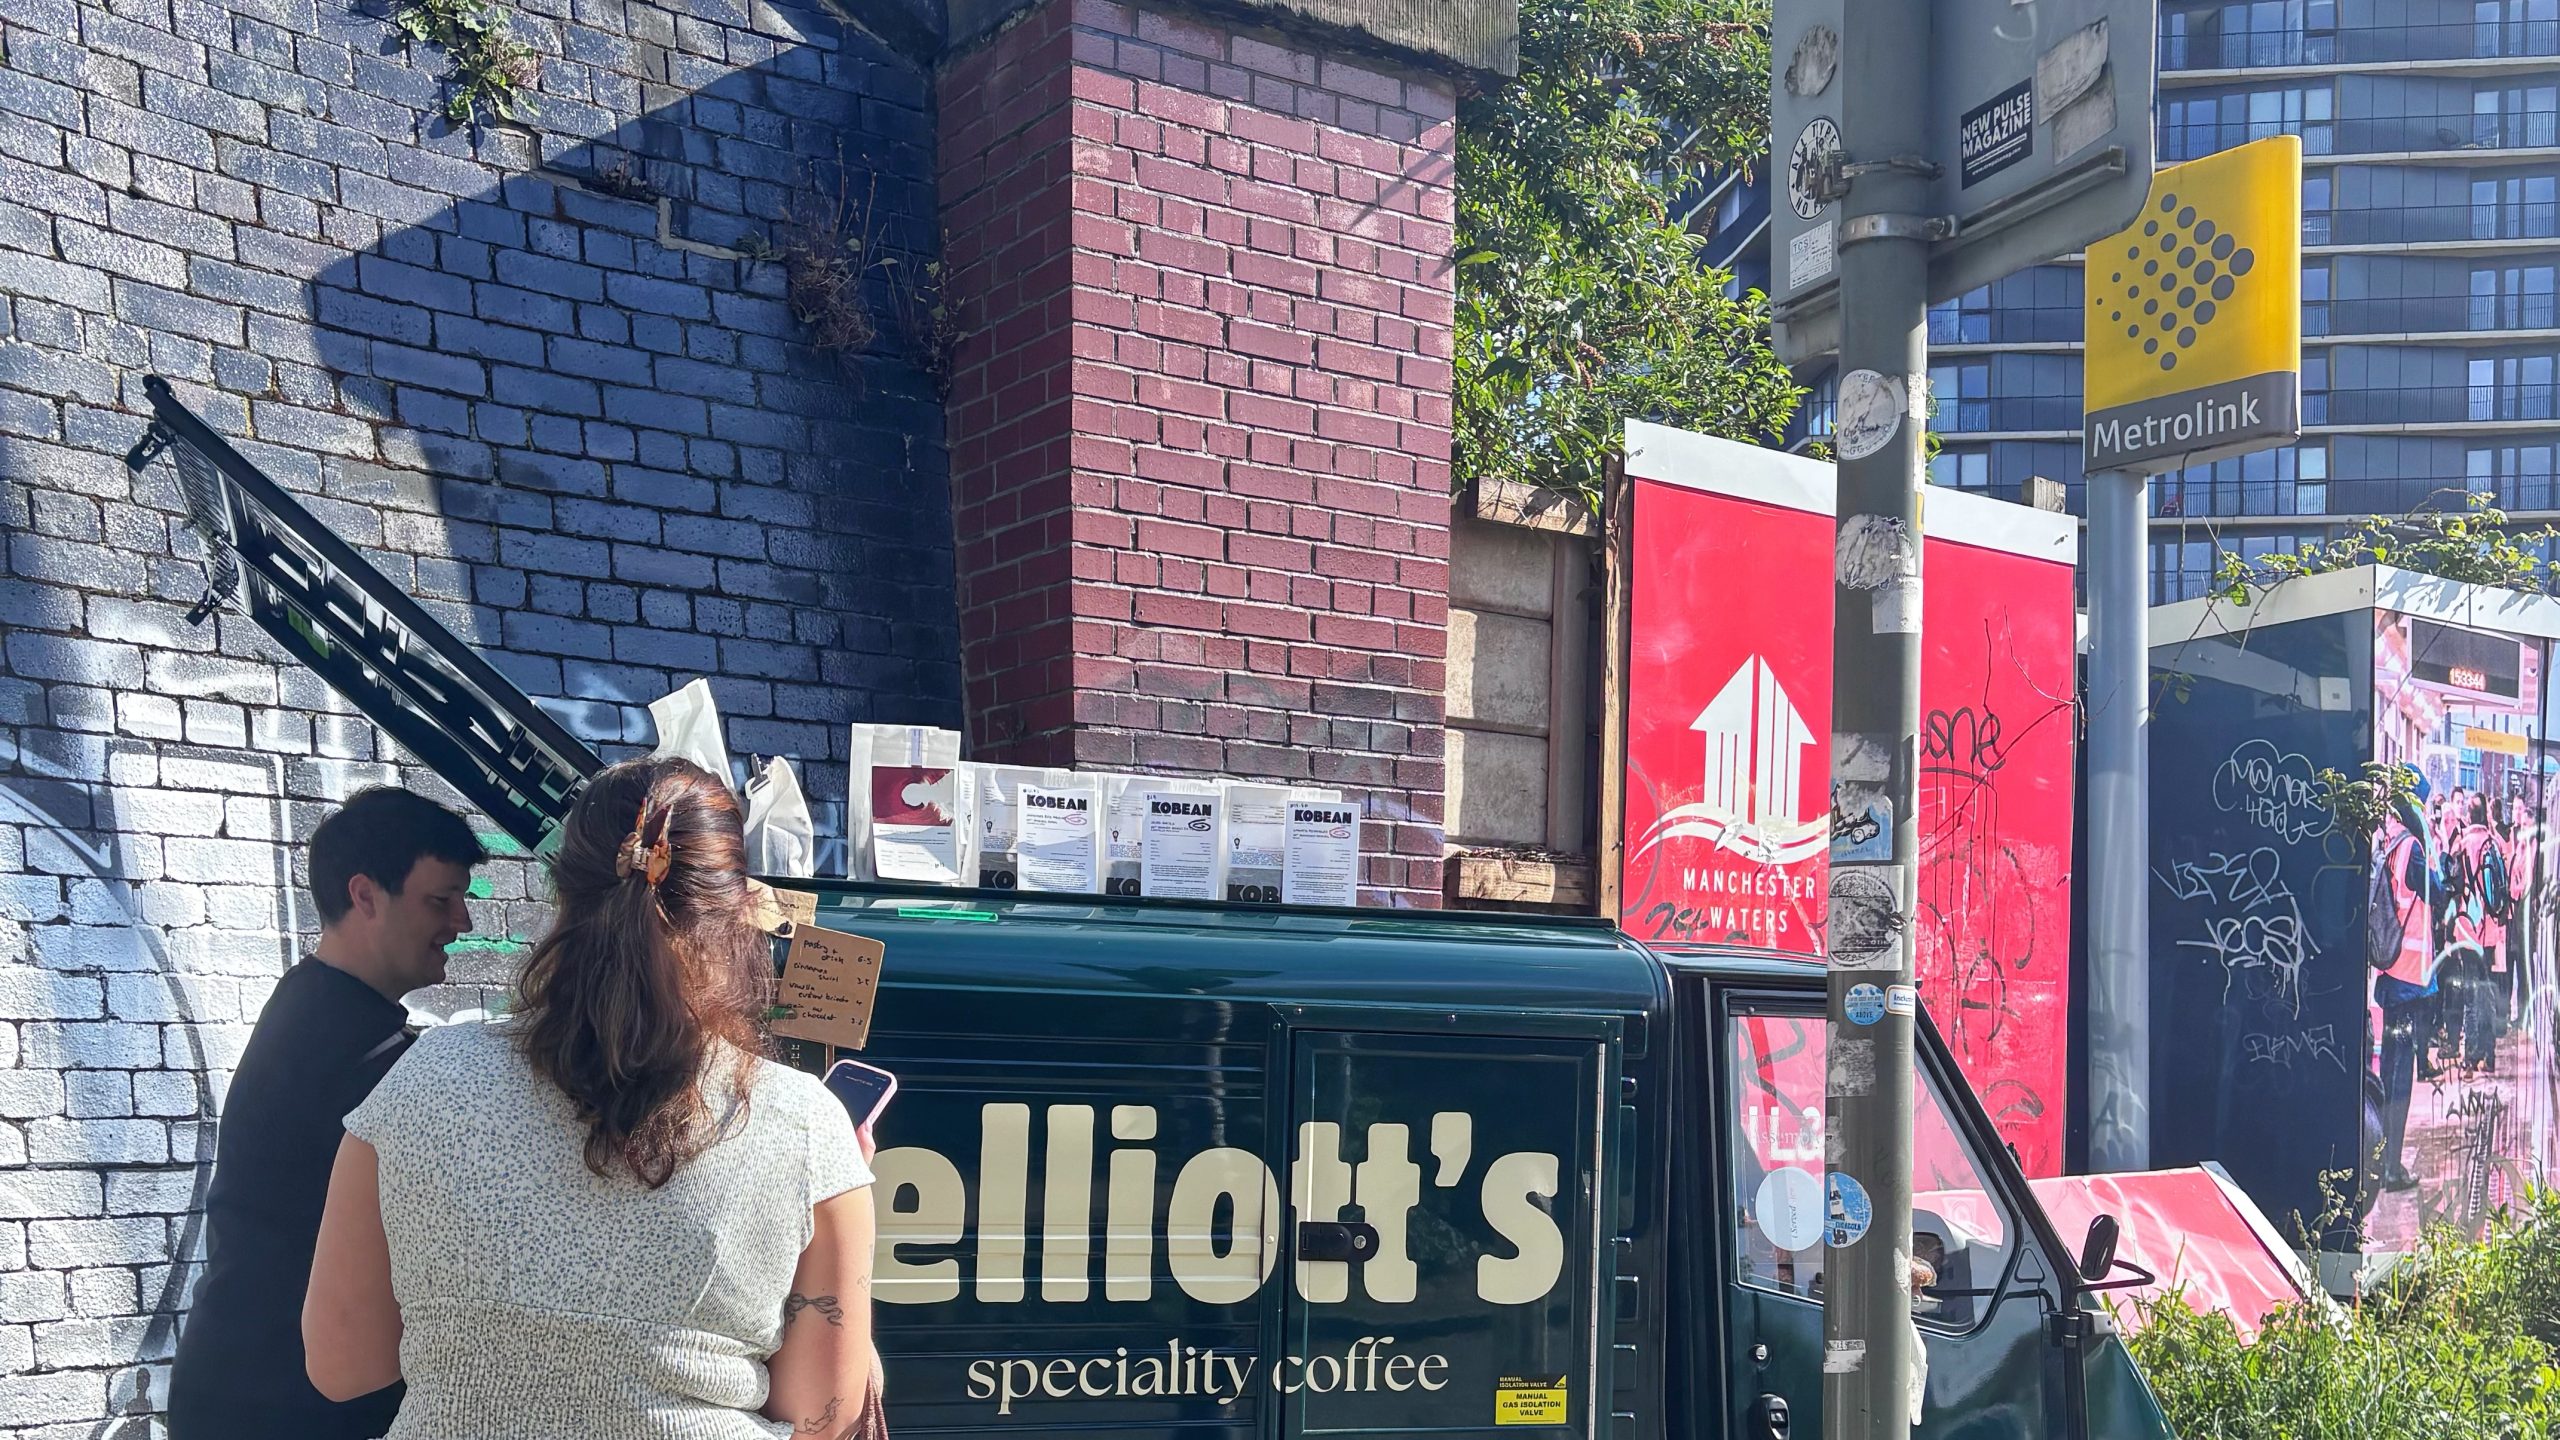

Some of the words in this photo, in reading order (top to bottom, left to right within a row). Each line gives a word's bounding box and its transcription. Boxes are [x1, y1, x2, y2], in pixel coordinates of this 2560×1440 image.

[1962, 110, 1991, 143] NEW
[1993, 91, 2031, 127] PULSE
[1962, 107, 2032, 159] MAGAZINE
[2091, 391, 2261, 459] Metrolink
[1026, 794, 1088, 811] KOBEAN
[1151, 801, 1212, 816] KOBEAN
[1294, 809, 1352, 824] KOBEAN
[1683, 867, 1816, 899] MANCHESTER
[1709, 906, 1788, 933] WATERS
[871, 1103, 1564, 1304] elliott's
[967, 1338, 1258, 1415] speciality
[1272, 1336, 1449, 1394] coffee
